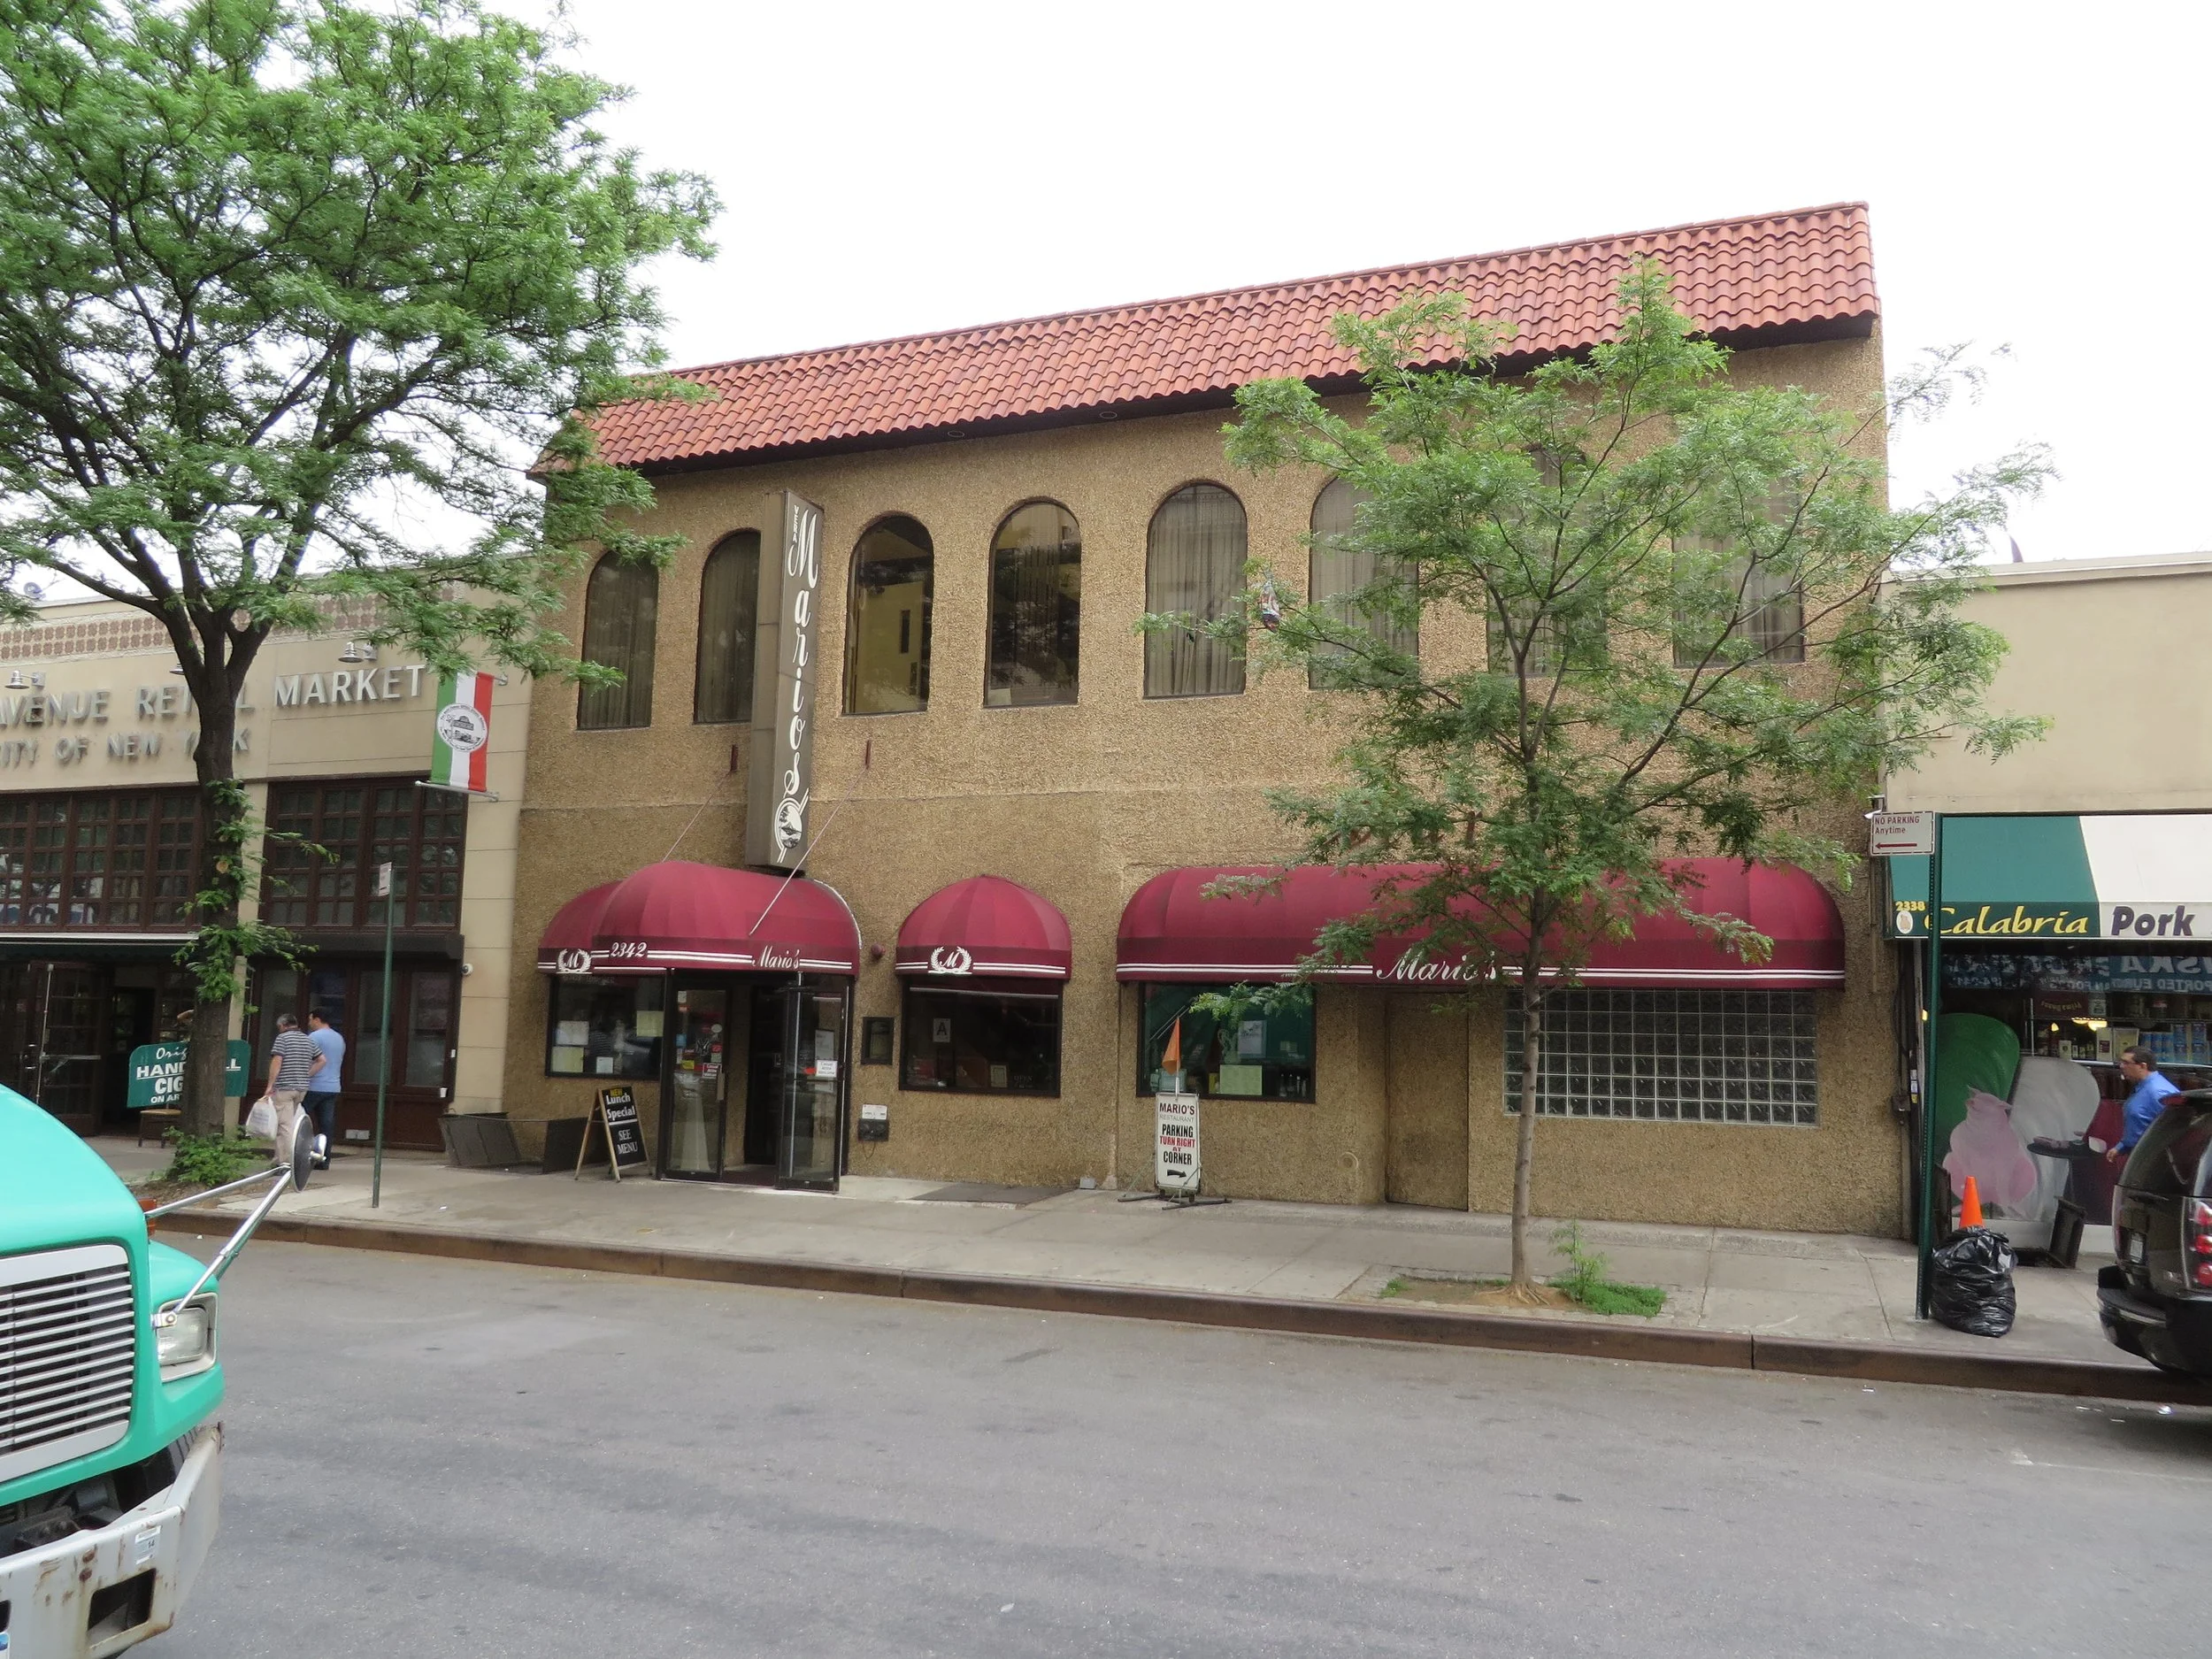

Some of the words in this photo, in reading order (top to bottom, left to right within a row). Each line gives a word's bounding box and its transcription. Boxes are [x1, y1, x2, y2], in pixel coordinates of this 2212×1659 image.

[135, 682, 255, 718] RETL
[274, 664, 426, 707] MARKET
[0, 738, 38, 766] ITY
[56, 735, 88, 762] OF
[106, 731, 160, 759] NEW
[182, 727, 250, 754] YK
[1875, 826, 1906, 835] Anytime
[1895, 901, 1926, 911] 2338
[1924, 905, 2088, 935] Calabria
[2110, 905, 2195, 936] Pork
[611, 942, 648, 958] 2342
[752, 945, 800, 970] Mario's
[564, 952, 580, 968] M
[940, 951, 960, 968] M
[936, 1021, 947, 1036] A
[156, 1047, 188, 1060] Orig
[155, 1076, 184, 1094] CIG
[150, 1094, 165, 1103] ON
[606, 1093, 631, 1105] Lunch
[607, 1105, 635, 1121] Special
[1159, 1102, 1194, 1115] MARIO'S
[618, 1129, 632, 1141] SEE
[1162, 1124, 1194, 1138] PARKING
[617, 1141, 638, 1154] MENU
[1160, 1136, 1176, 1145] TURN
[1177, 1138, 1195, 1148] RIGHT
[1164, 1150, 1193, 1165] CORNER
